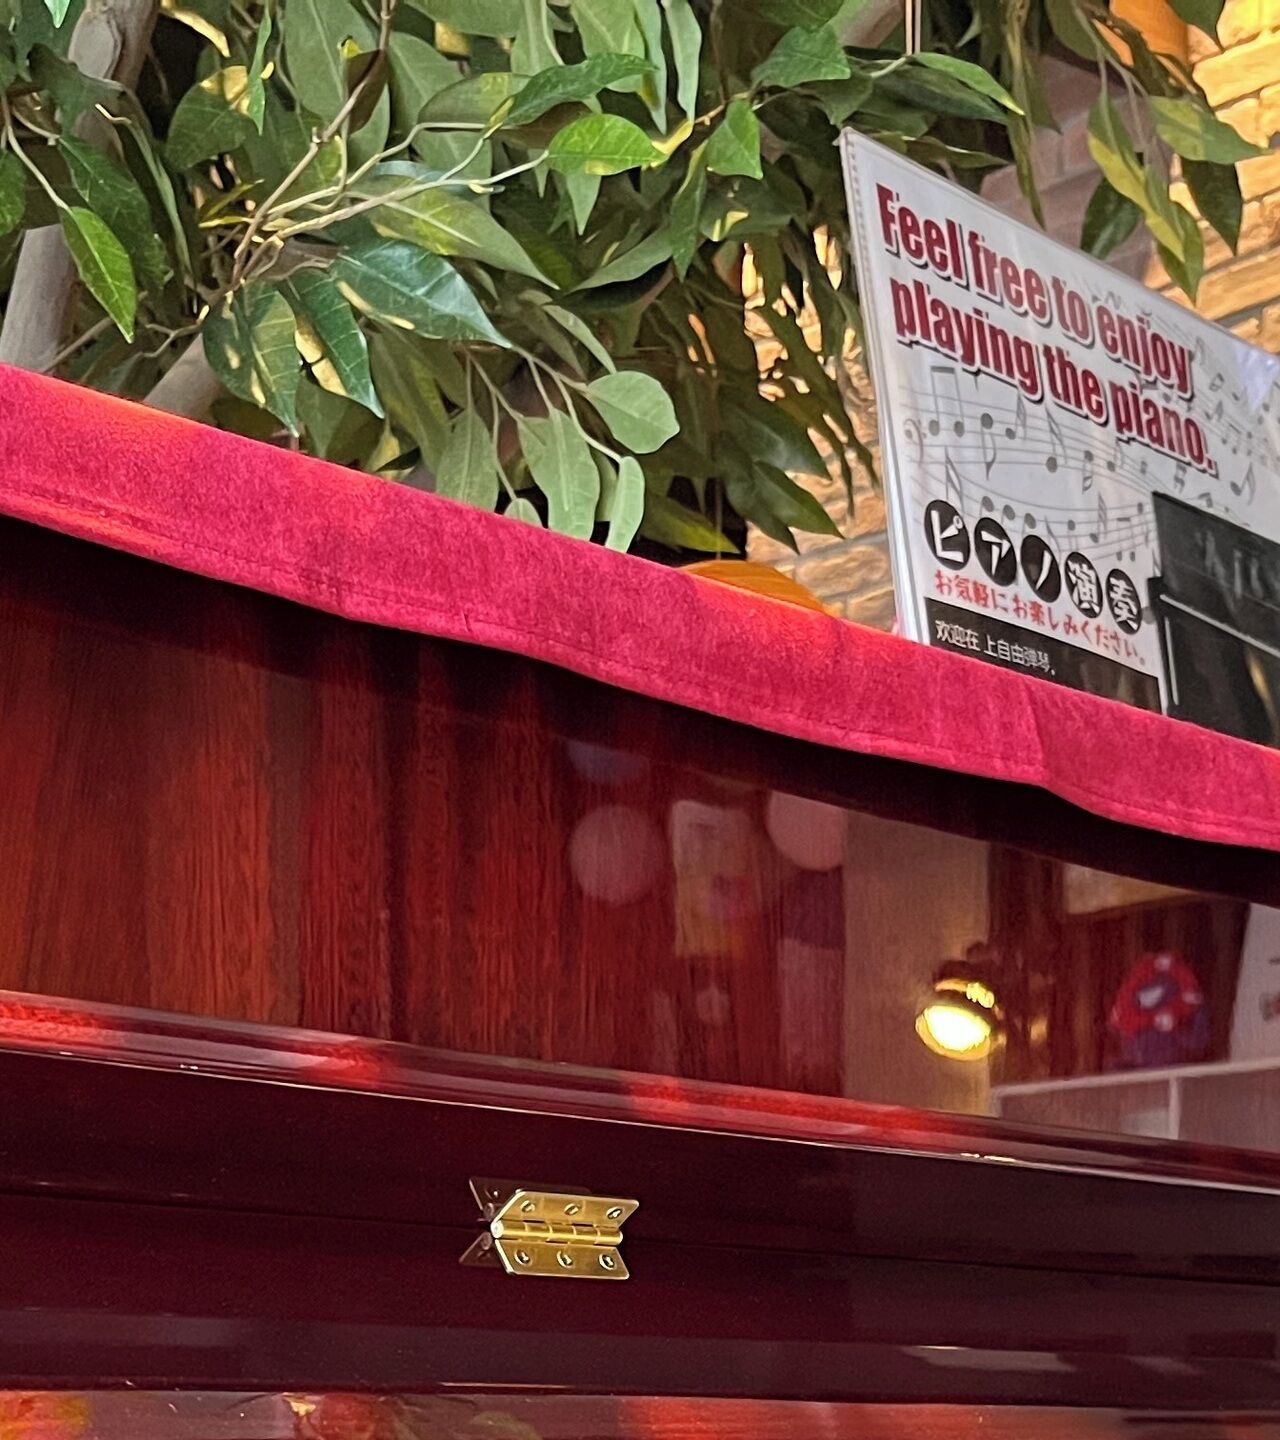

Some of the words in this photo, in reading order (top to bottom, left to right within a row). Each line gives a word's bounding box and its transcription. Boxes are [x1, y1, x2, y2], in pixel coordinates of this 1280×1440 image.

[876, 182, 967, 289] Feel
[968, 229, 1052, 327] free
[1051, 274, 1095, 348] to
[1096, 302, 1195, 400] enjoy
[889, 276, 1044, 403] playing
[1042, 343, 1109, 426] the
[1109, 379, 1220, 480] piano.
[925, 500, 1142, 634] ピアノ演奏
[934, 568, 1146, 666] お気軽にお楽しみください。
